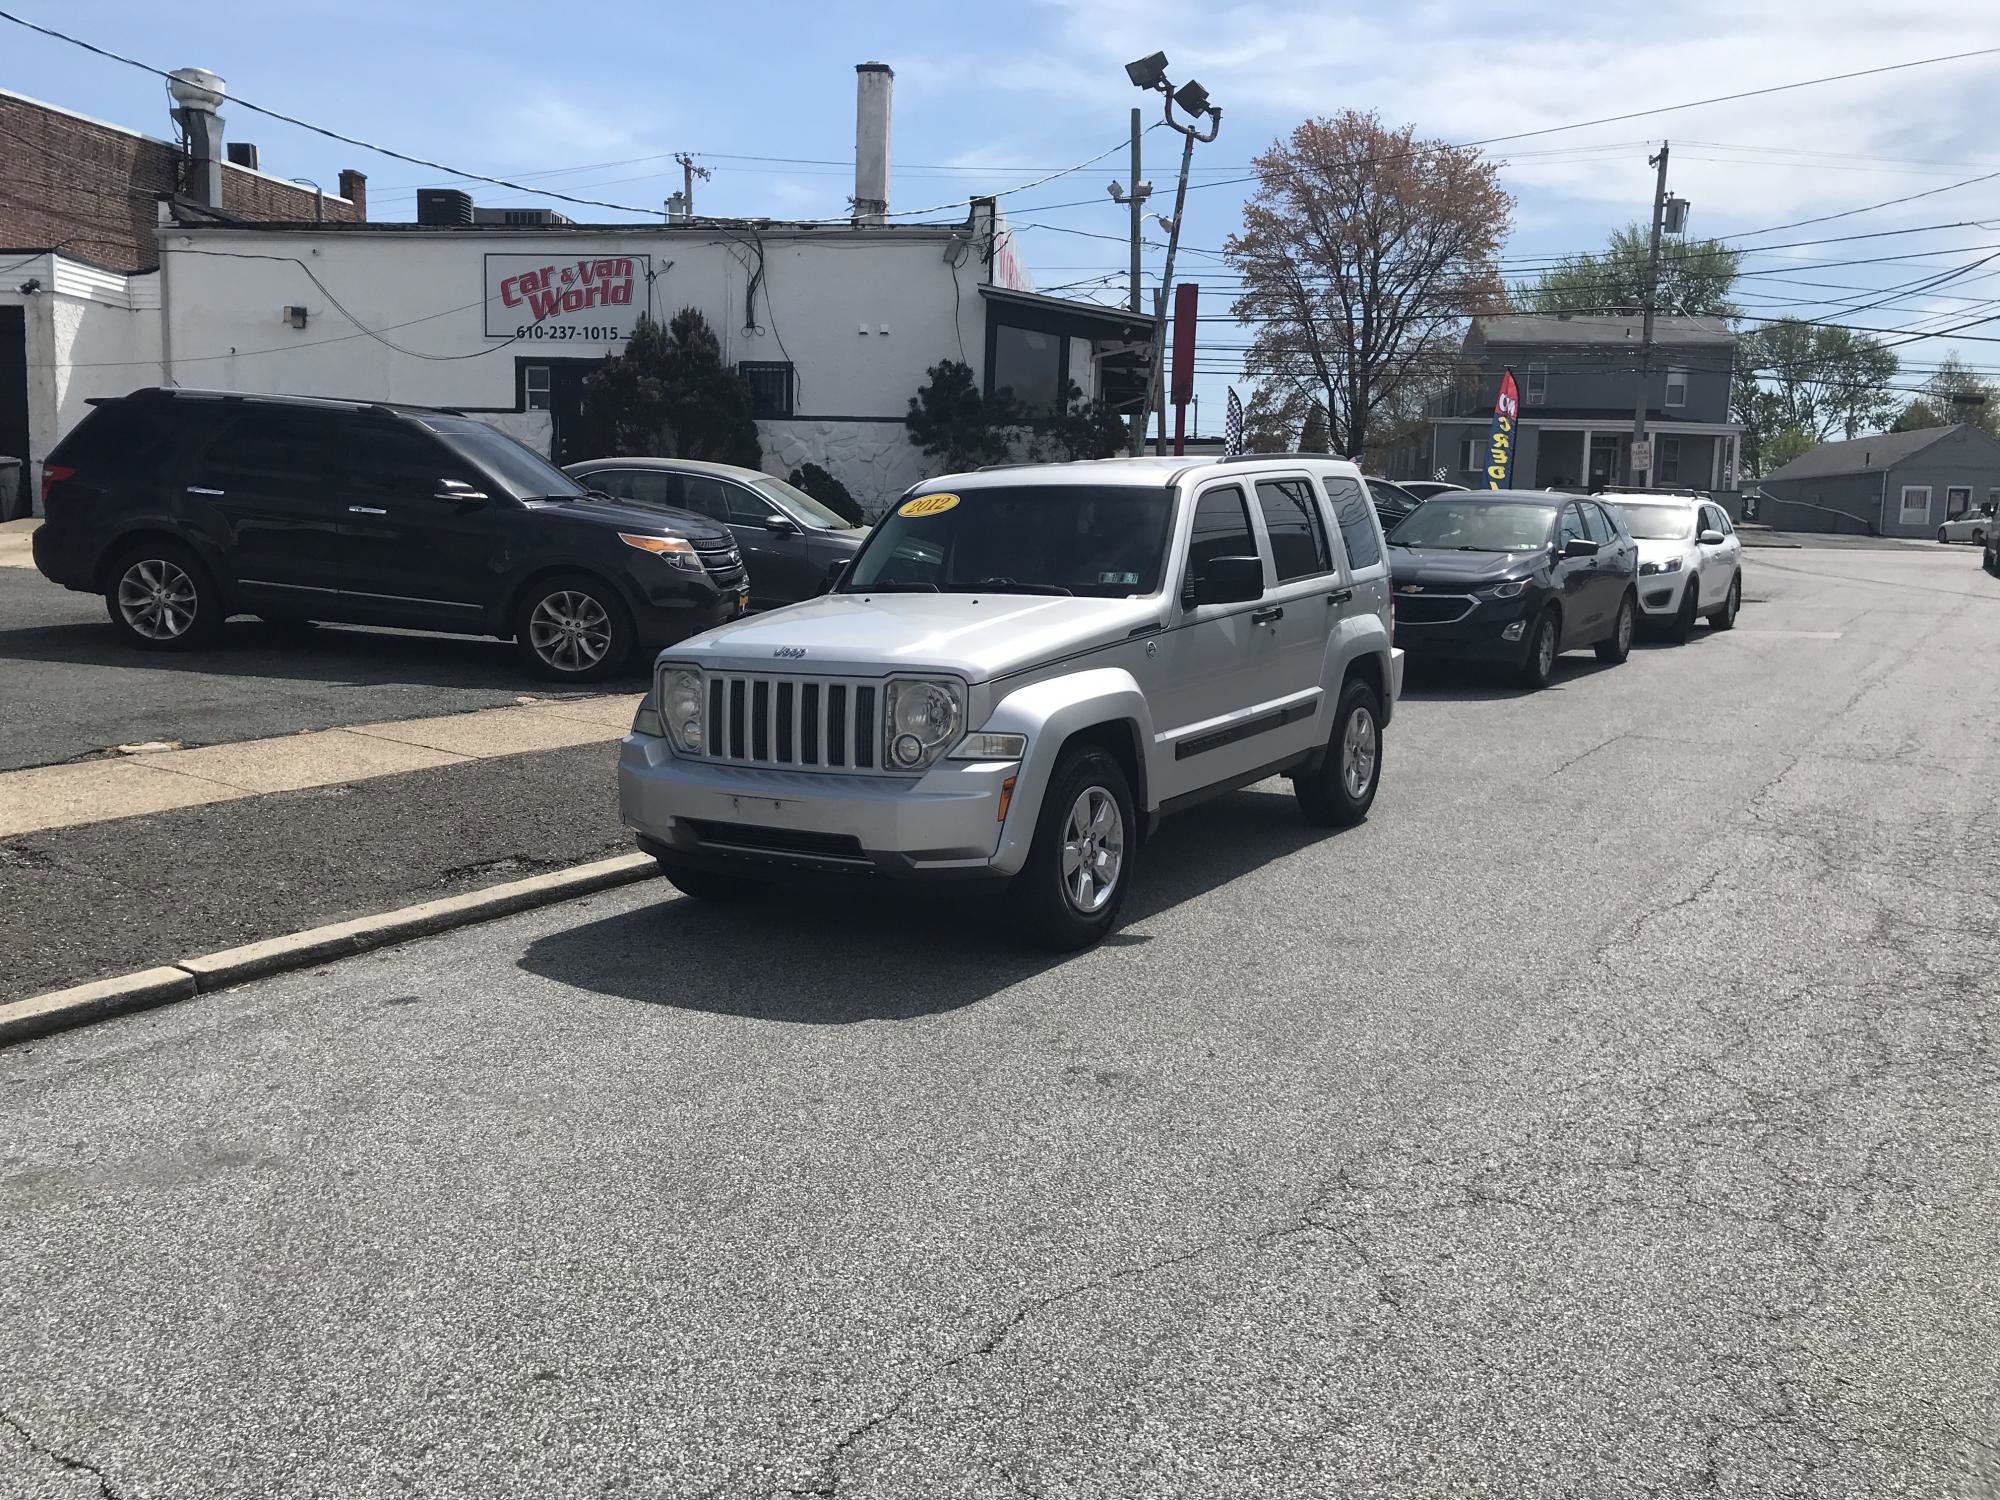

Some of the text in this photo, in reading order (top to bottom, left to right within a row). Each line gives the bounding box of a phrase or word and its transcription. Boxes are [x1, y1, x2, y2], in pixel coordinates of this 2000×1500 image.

[500, 258, 634, 308] Car & Van
[528, 278, 634, 321] World
[516, 325, 618, 341] 610-237-1015
[904, 497, 952, 514] 2012
[773, 646, 808, 660] Jeep
